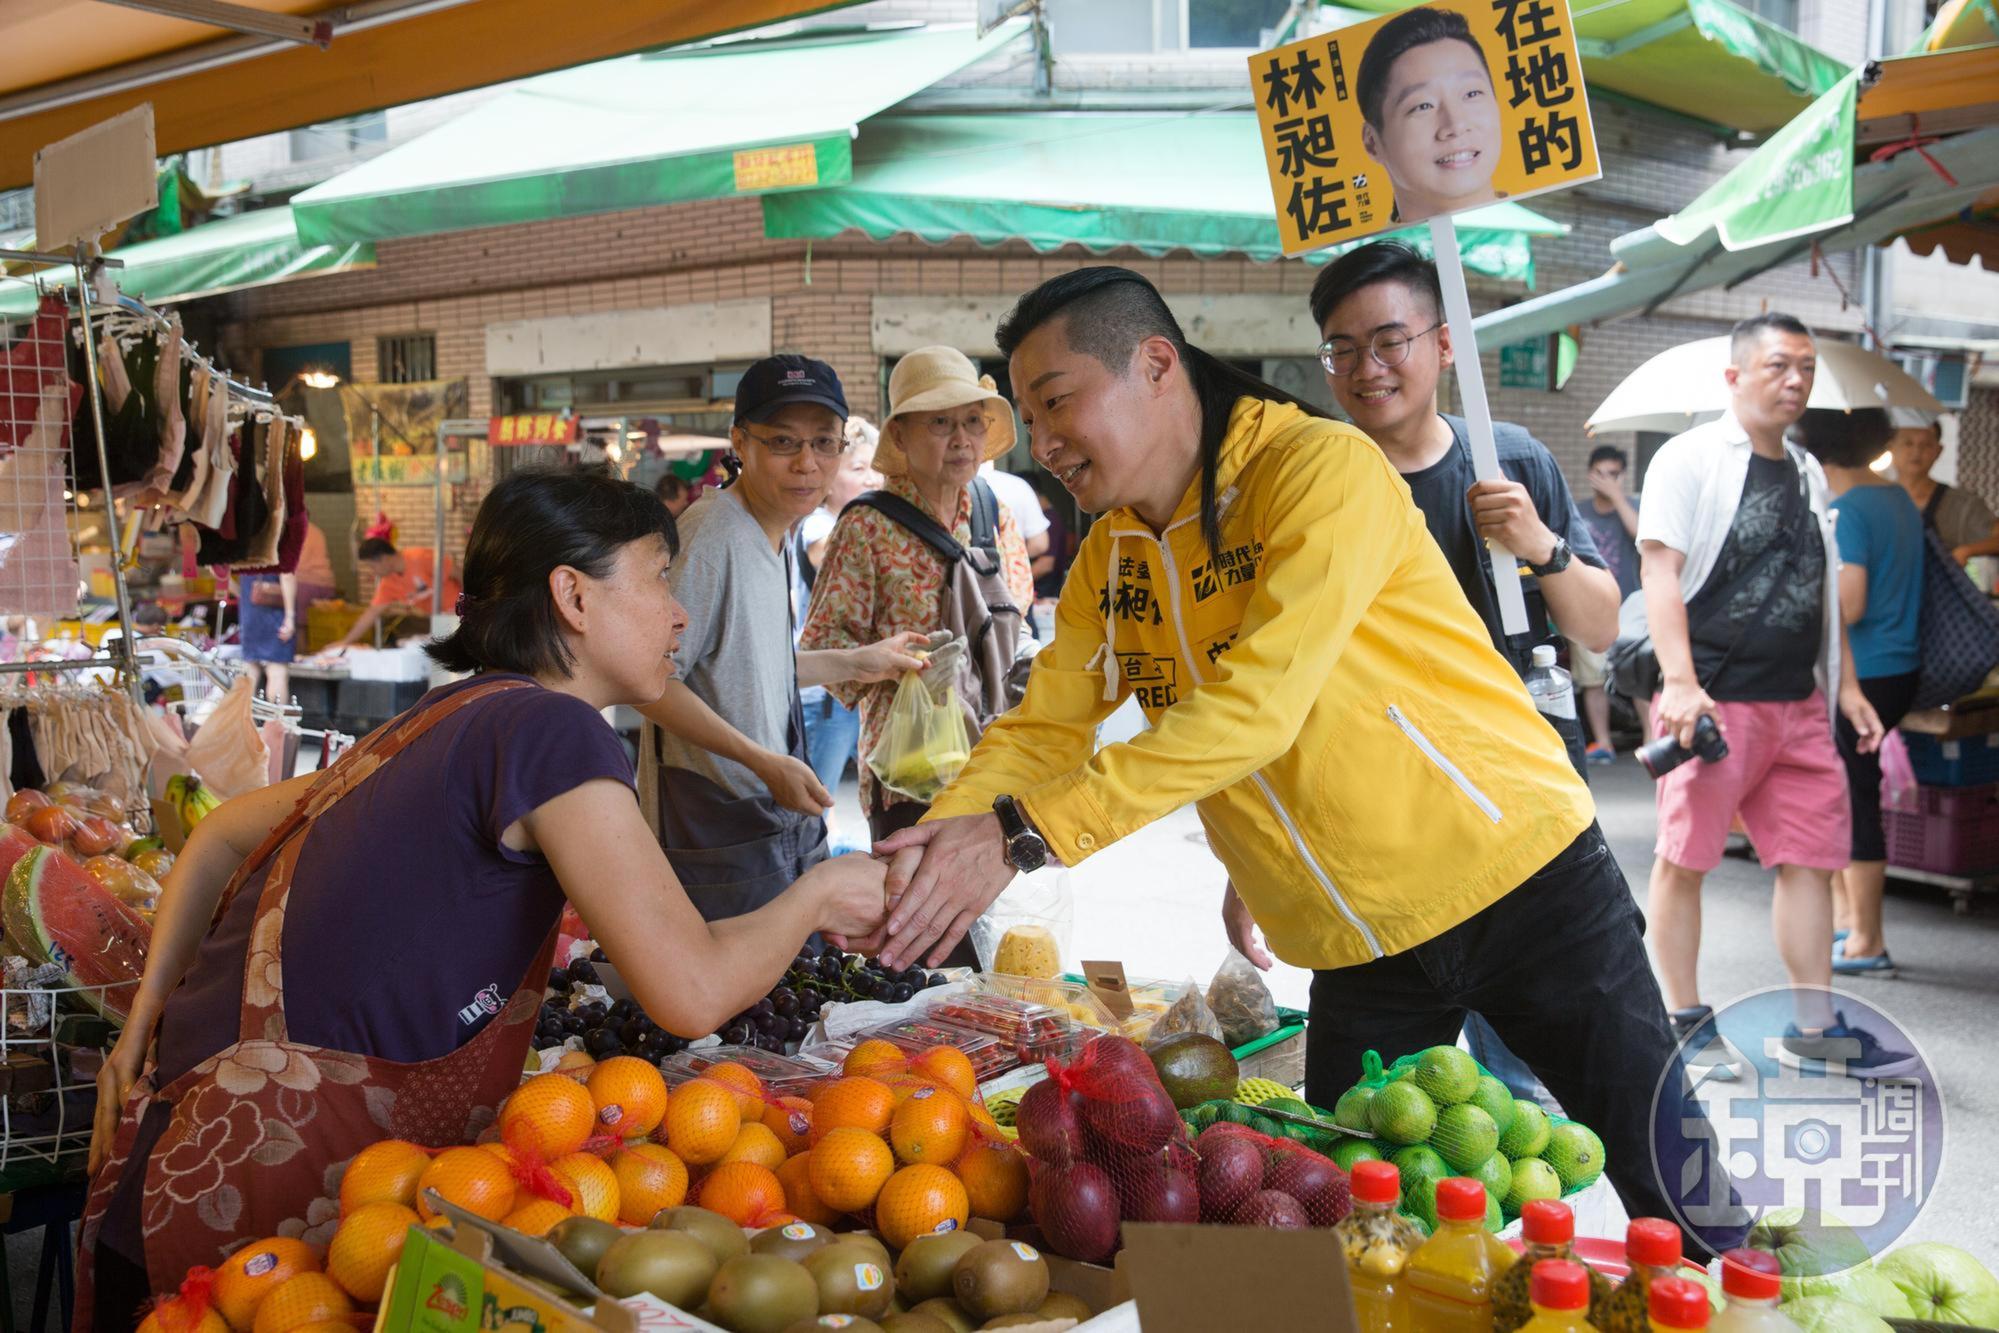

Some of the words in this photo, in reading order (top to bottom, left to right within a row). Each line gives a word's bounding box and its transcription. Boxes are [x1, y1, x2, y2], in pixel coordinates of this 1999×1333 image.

[1495, 0, 1583, 175] 在地的
[1262, 49, 1352, 241] 林昶佐
[1219, 545, 1253, 569] 時代
[1225, 562, 1256, 586] 力量
